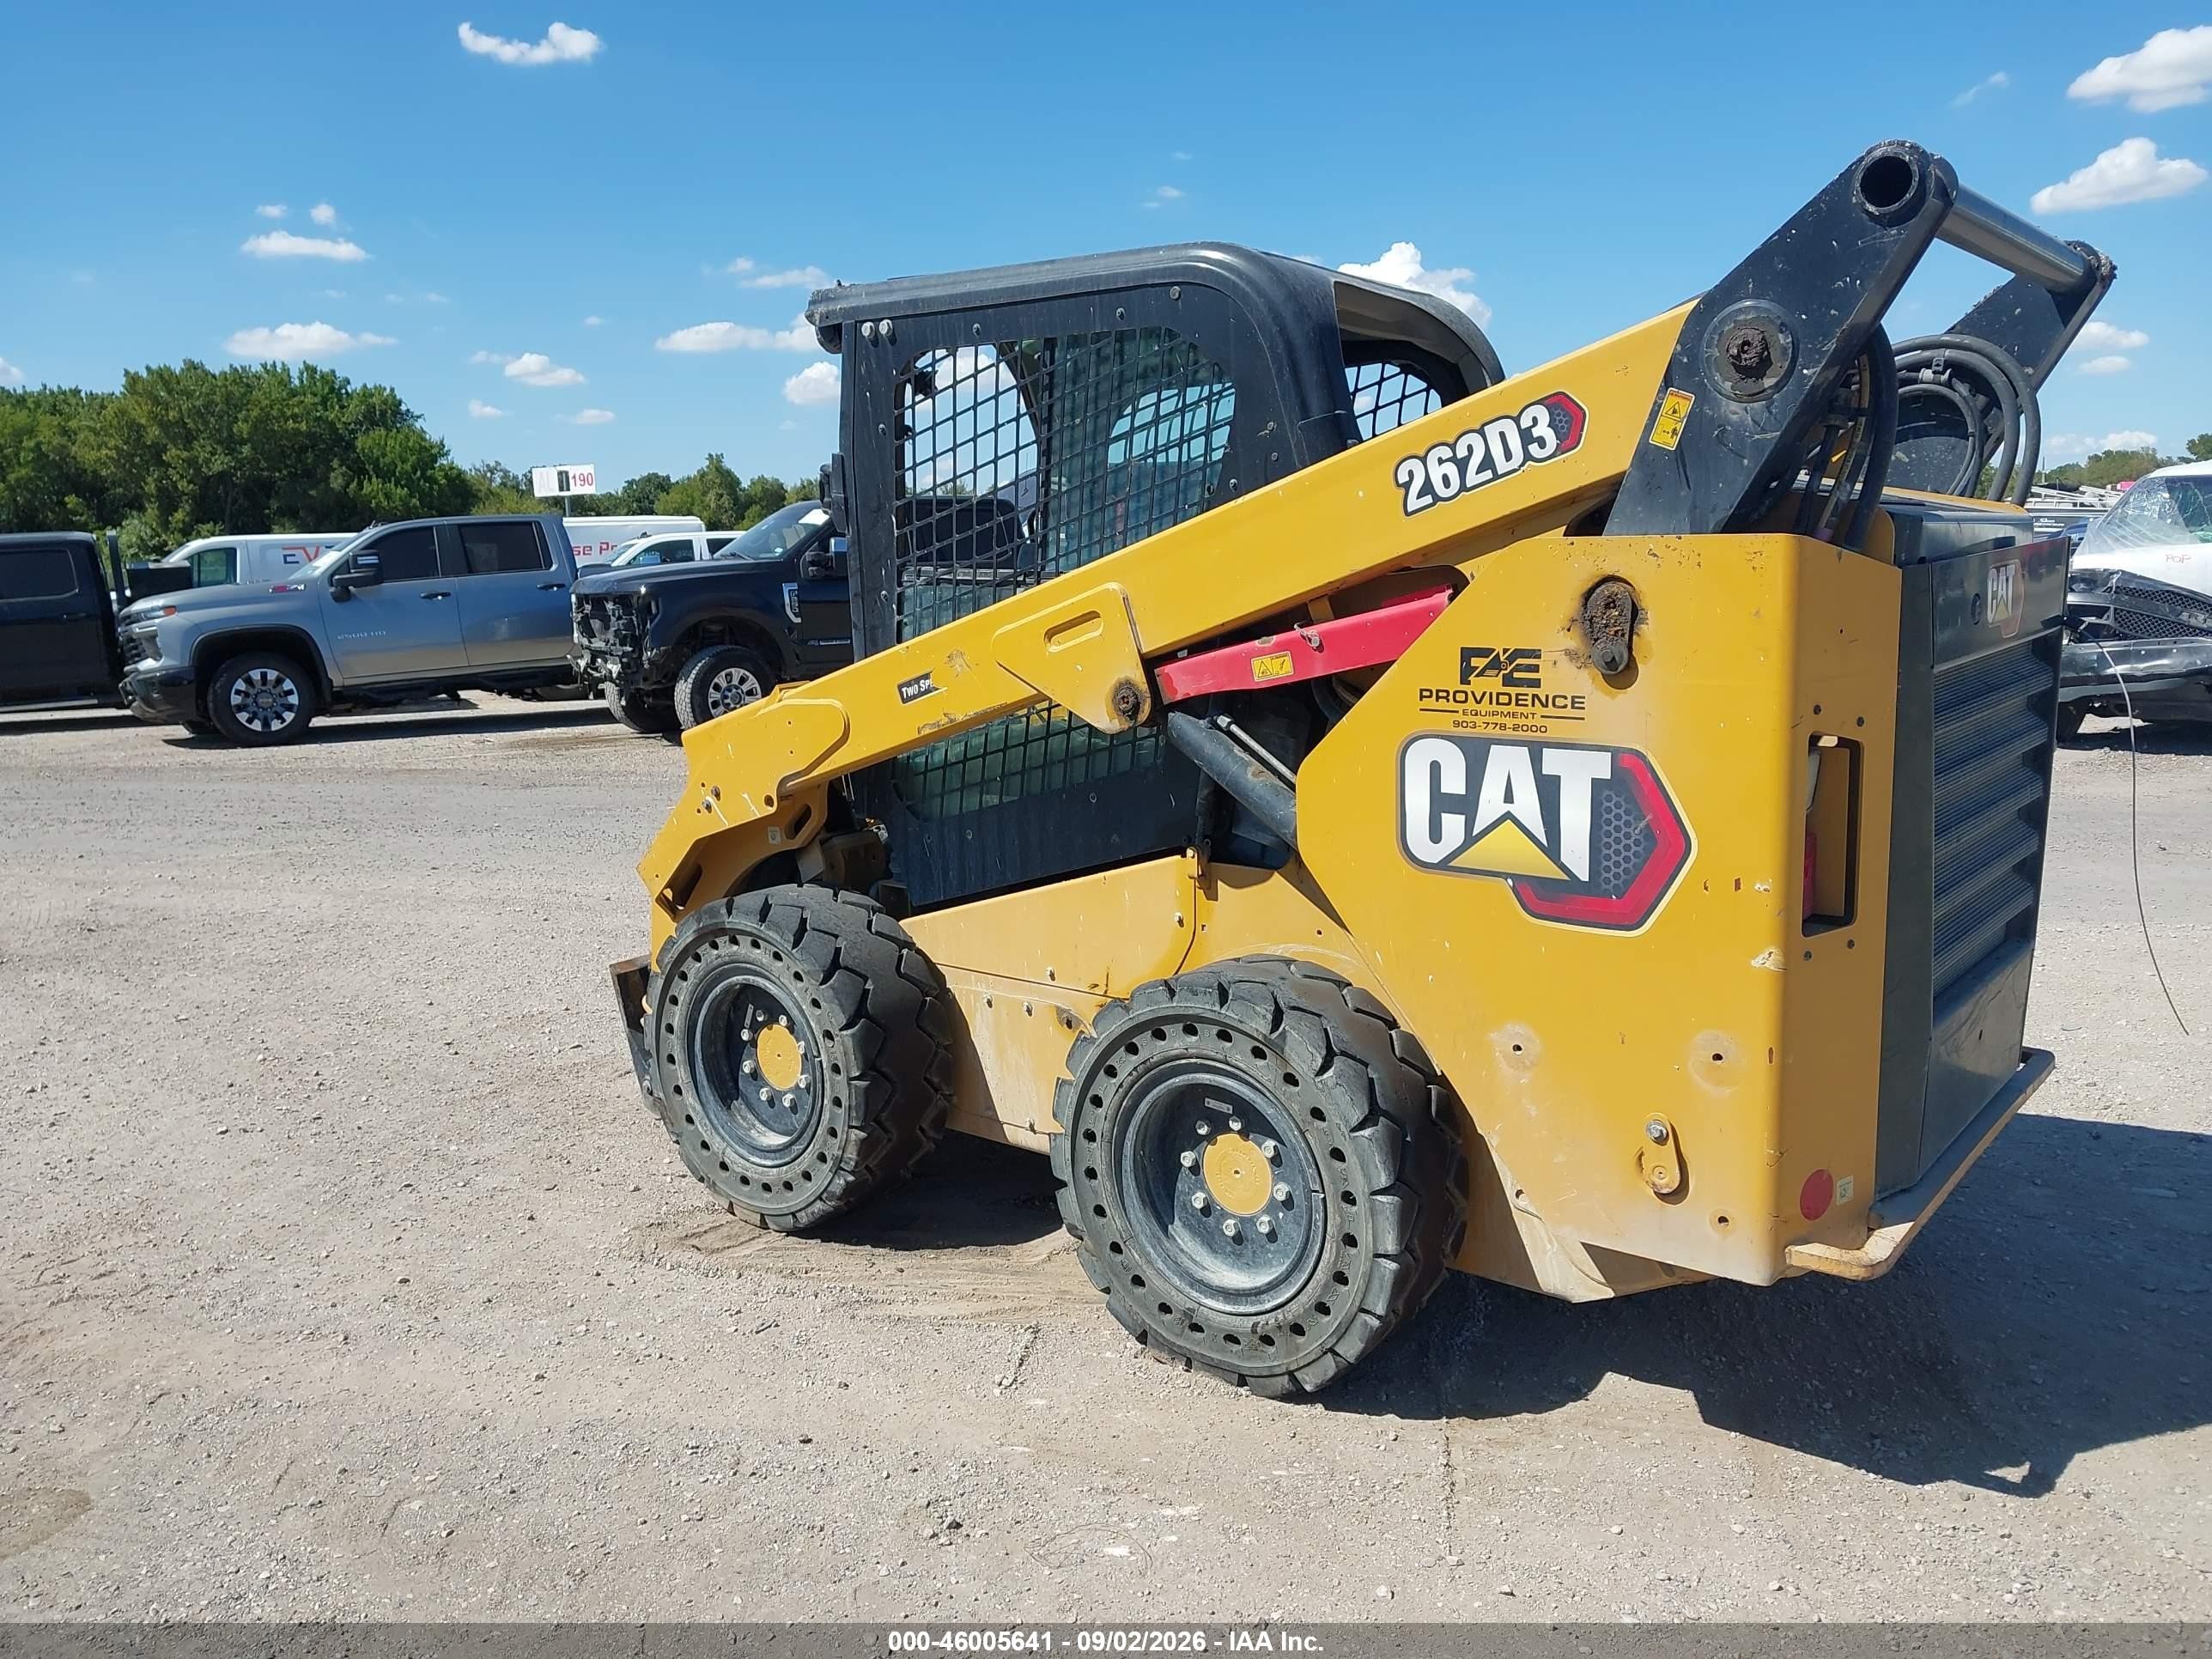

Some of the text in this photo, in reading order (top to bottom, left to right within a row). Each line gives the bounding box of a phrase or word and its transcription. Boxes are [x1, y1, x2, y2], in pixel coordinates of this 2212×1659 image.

[1397, 404, 1557, 514] 262D3
[571, 472, 594, 487] 190
[1987, 564, 2015, 623] CAT
[902, 679, 933, 699] TWO SP
[1419, 688, 1586, 710] PROVIDENCE
[1462, 709, 1537, 720] EQUIPMENT
[1452, 720, 1548, 733] 903-778-2000
[1404, 738, 1613, 883] CAT
